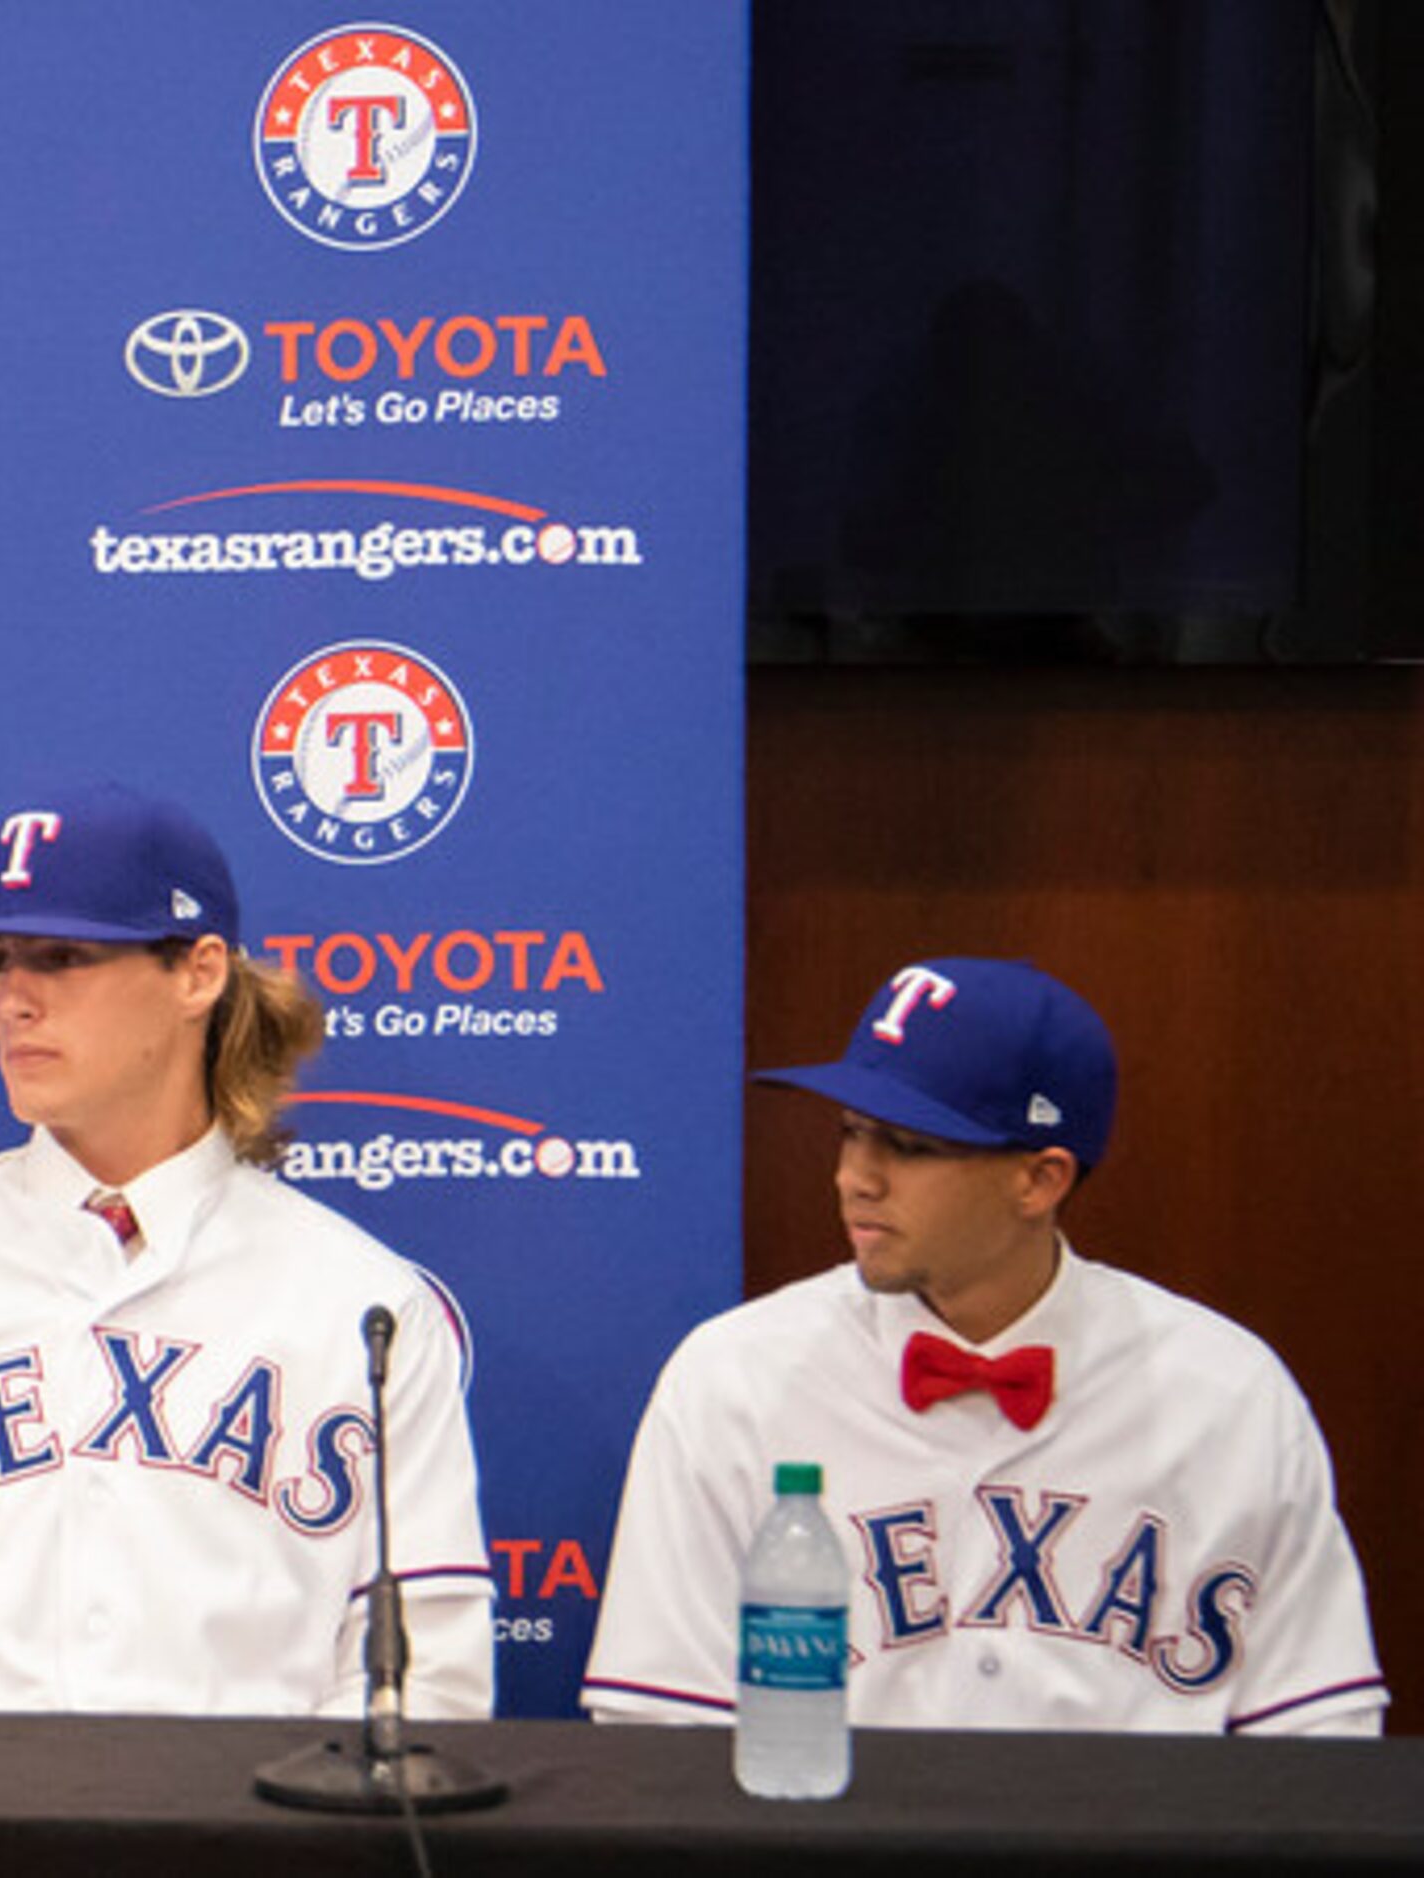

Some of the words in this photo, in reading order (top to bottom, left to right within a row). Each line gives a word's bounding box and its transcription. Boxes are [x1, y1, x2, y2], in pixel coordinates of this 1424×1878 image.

[289, 40, 440, 91] TEXAS
[329, 96, 405, 186] T
[272, 153, 460, 236] RANGERS
[265, 315, 606, 382] TOYOTA
[278, 392, 366, 428] Let's
[375, 390, 429, 425] Go
[433, 389, 561, 423] Places
[88, 521, 644, 581] texasrangers.com
[286, 656, 438, 707] TEXAS
[326, 712, 402, 801] T
[270, 769, 457, 851] RANGERS
[0, 811, 63, 890] T
[262, 931, 604, 994] TOYOTA
[324, 1005, 365, 1038] t's
[374, 1004, 428, 1037] Go
[433, 1003, 558, 1036] Places
[872, 965, 957, 1044] T
[846, 1486, 1262, 1695] EXAS
